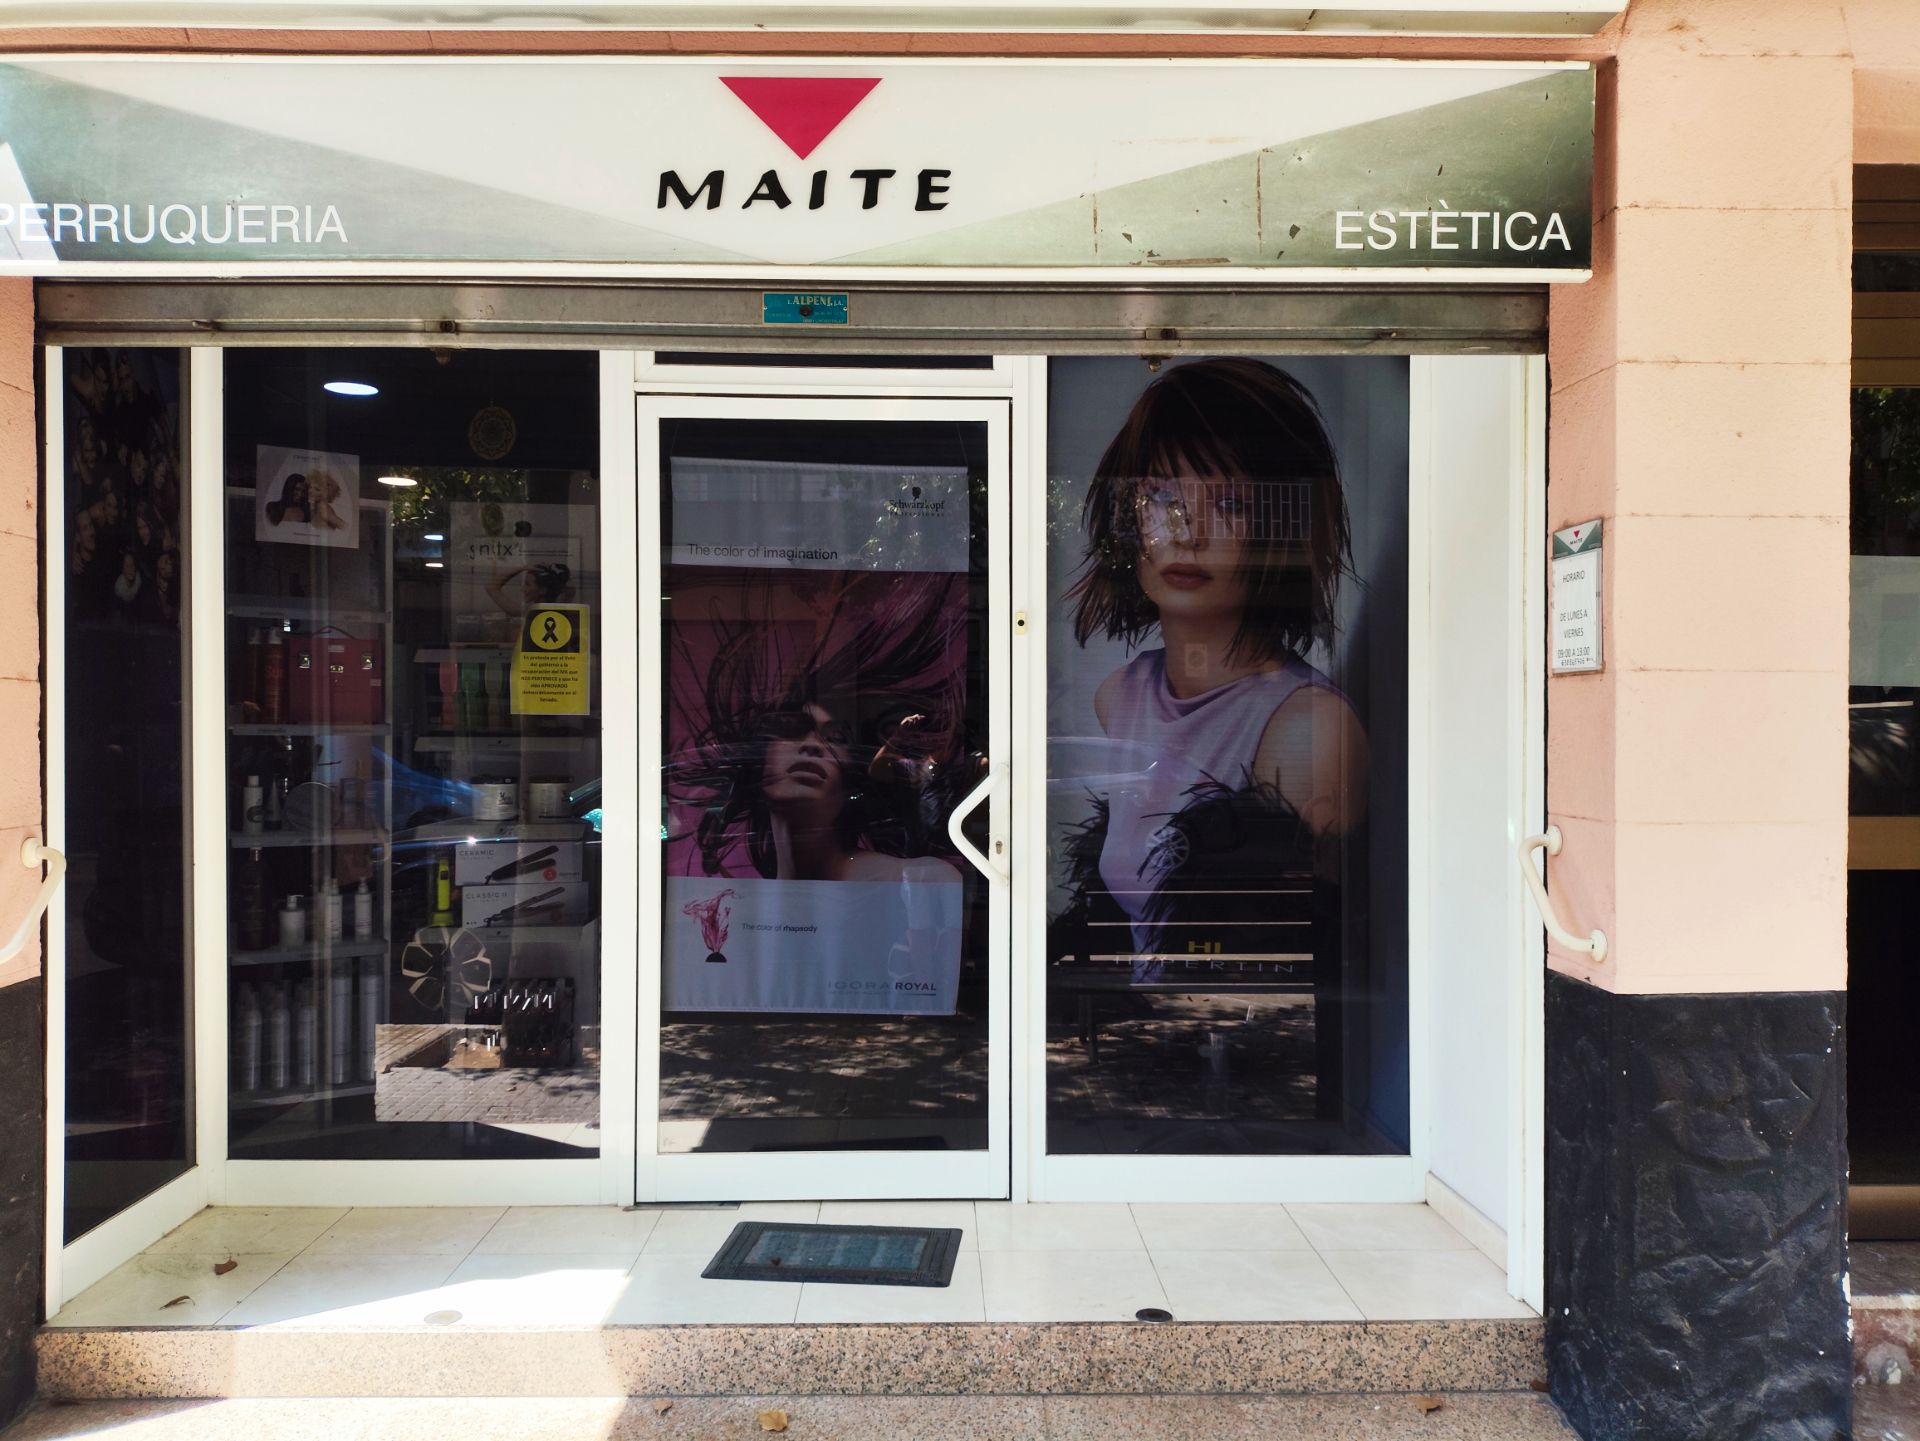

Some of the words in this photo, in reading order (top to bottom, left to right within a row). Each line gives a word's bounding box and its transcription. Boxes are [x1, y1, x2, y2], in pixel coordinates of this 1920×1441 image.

[657, 169, 952, 212] MAITE
[1334, 199, 1572, 251] ESTÈTICA
[688, 543, 711, 556] The
[713, 545, 745, 557] color
[747, 545, 759, 558] of
[763, 546, 838, 561] imagination
[1188, 940, 1222, 954] HI
[828, 980, 889, 990] IGORA
[895, 981, 937, 991] ROYAL
